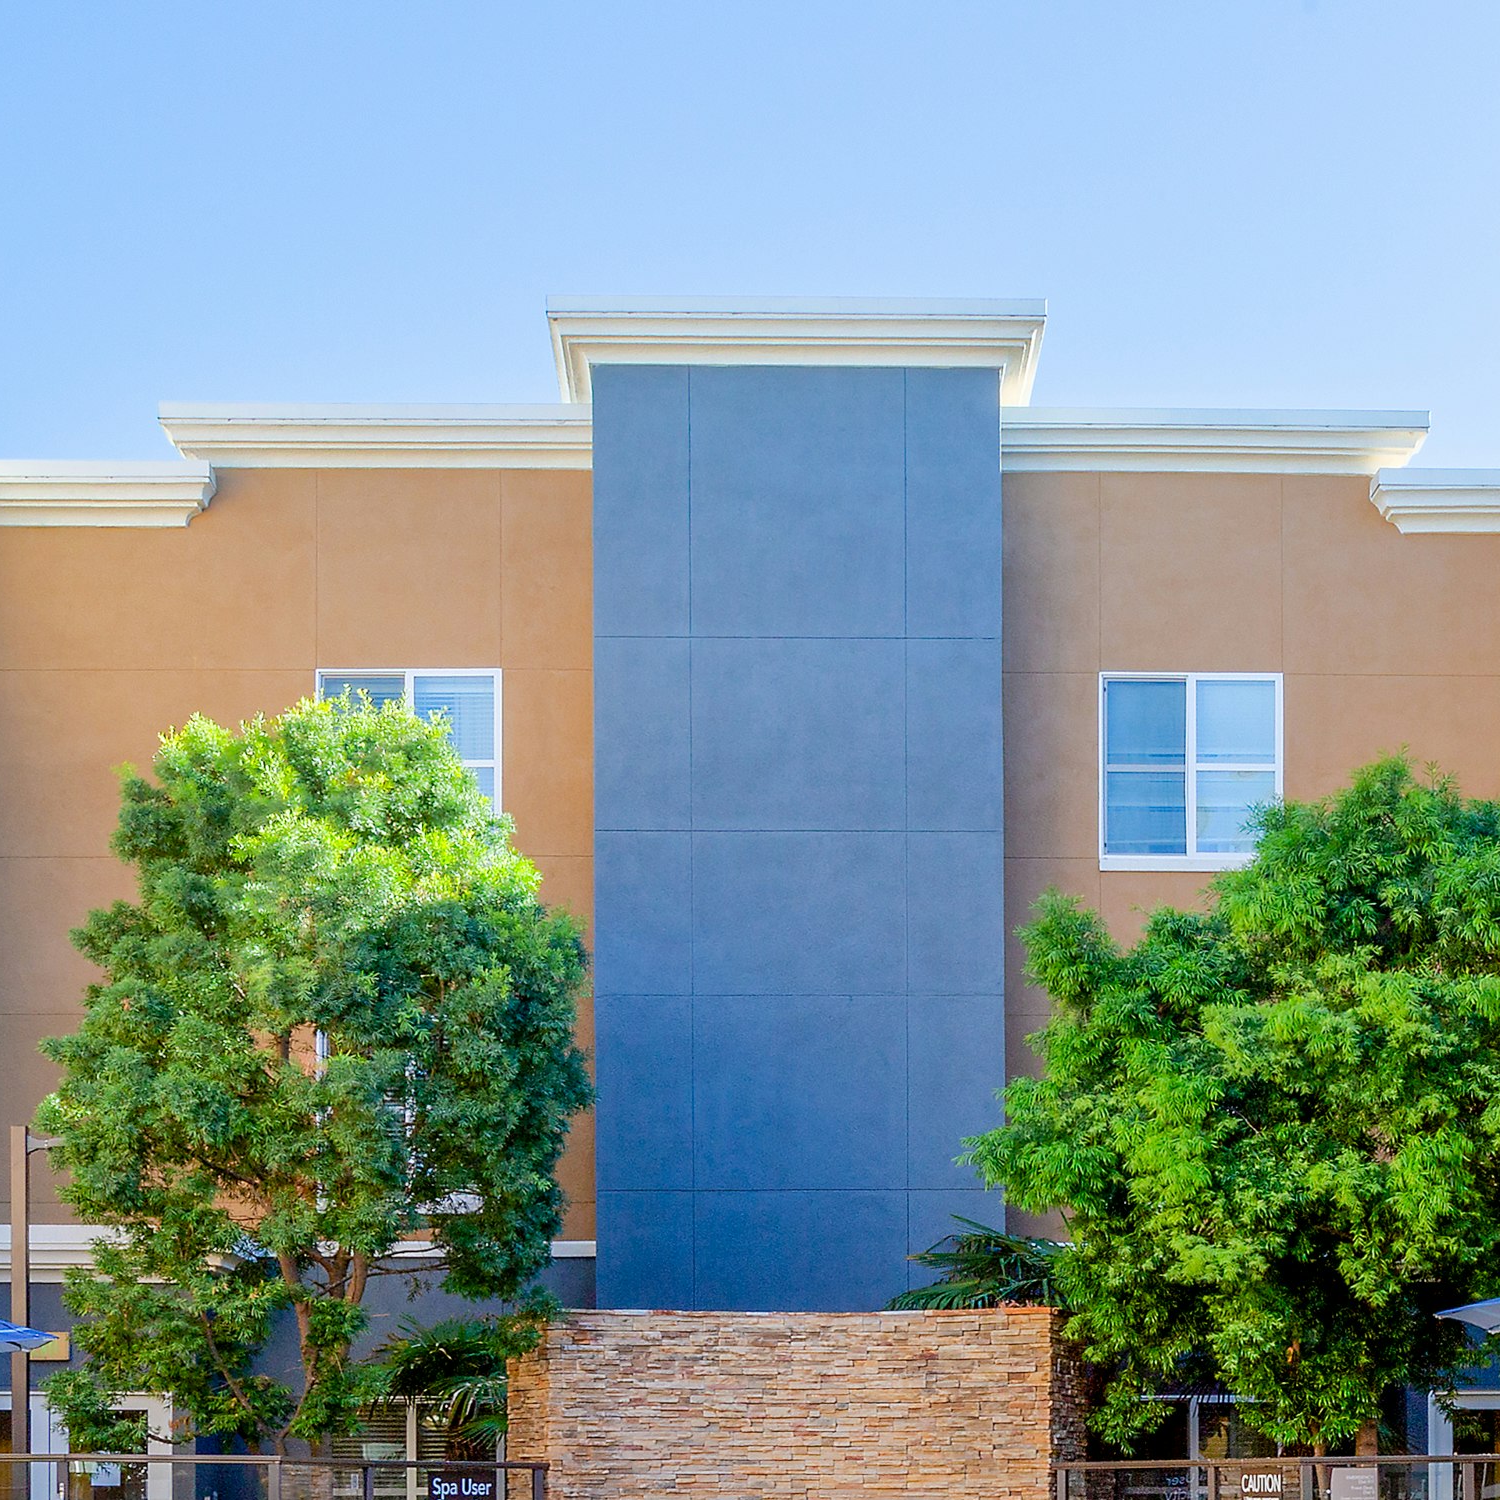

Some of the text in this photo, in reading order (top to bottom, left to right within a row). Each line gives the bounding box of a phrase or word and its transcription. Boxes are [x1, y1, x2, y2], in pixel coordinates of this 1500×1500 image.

[432, 1477, 492, 1500] Spa User
[1241, 1474, 1282, 1493] CAUTION
